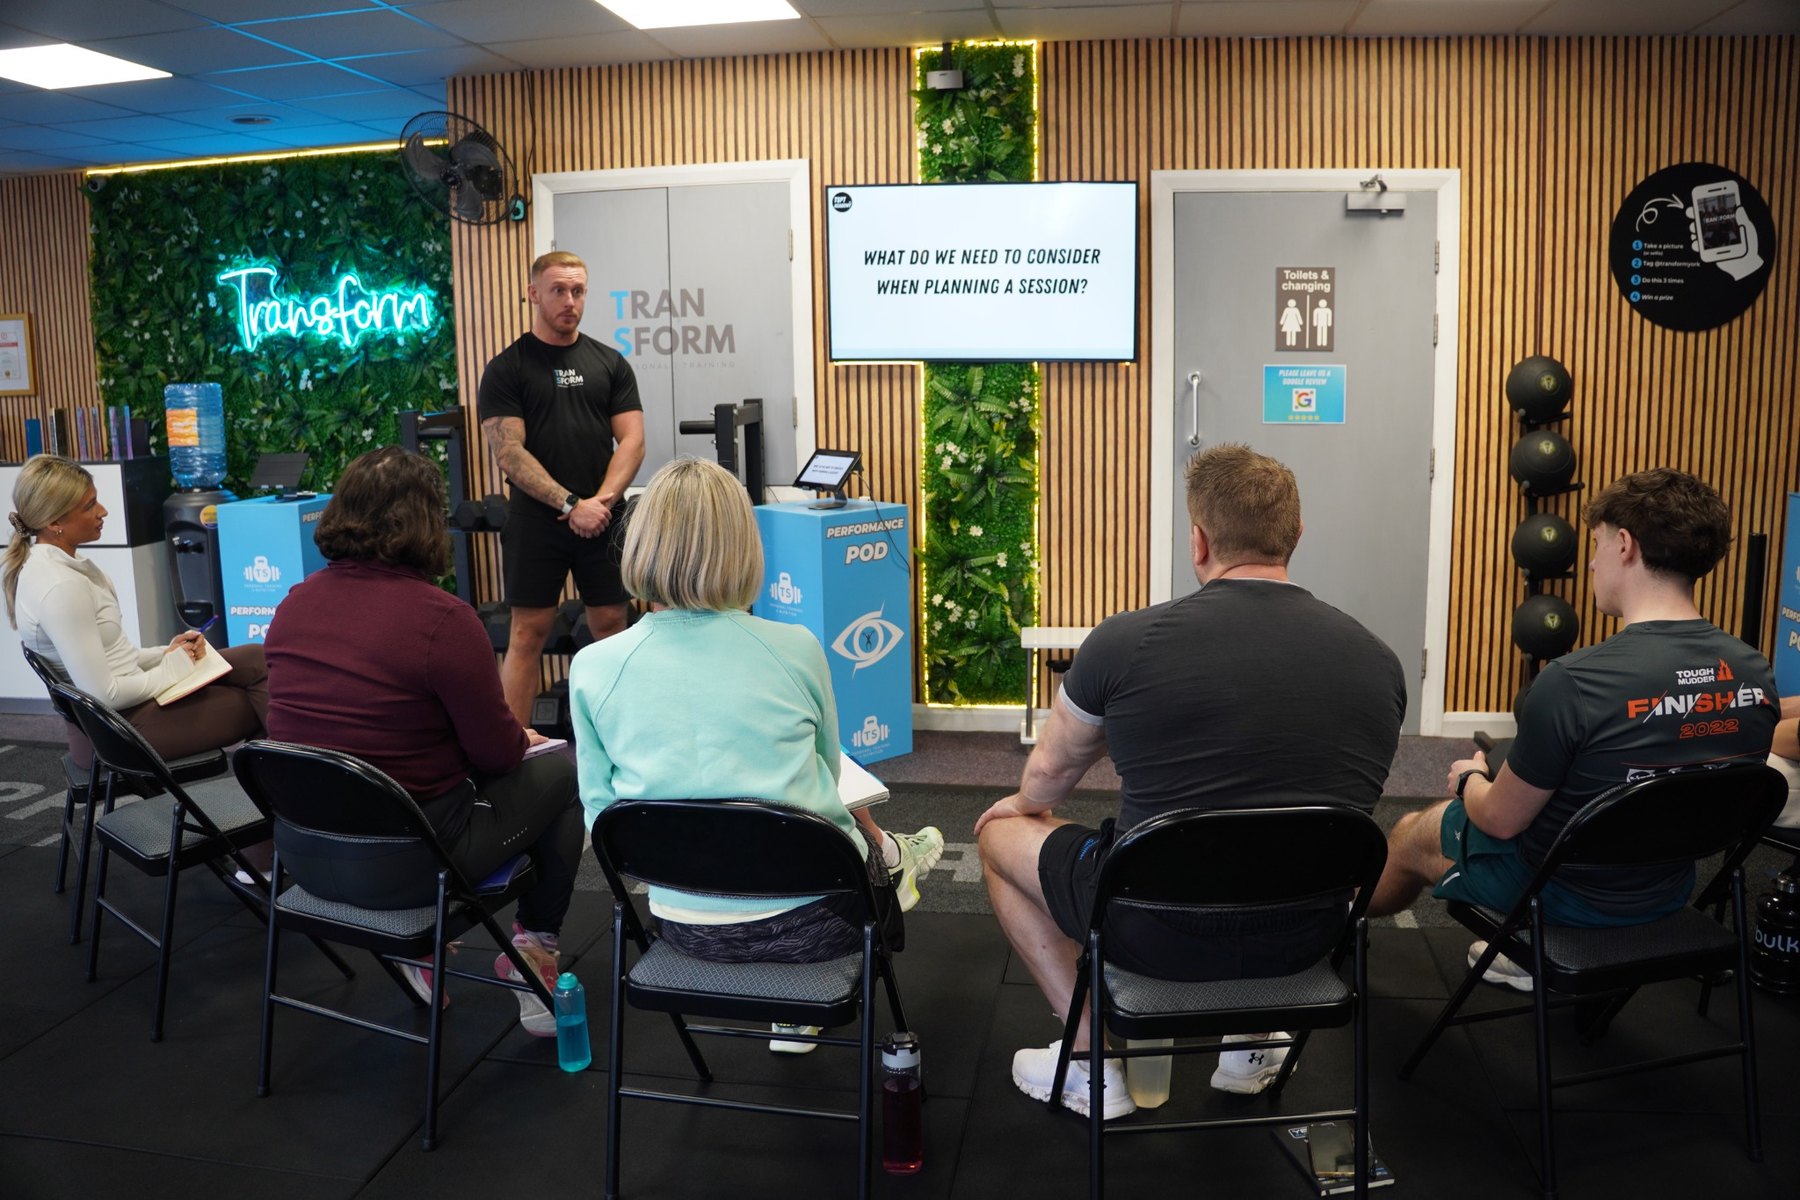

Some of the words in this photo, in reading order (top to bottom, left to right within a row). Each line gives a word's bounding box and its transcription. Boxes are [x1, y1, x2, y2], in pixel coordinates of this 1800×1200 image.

[864, 250, 905, 265] WHAT
[909, 250, 929, 265] DO
[935, 249, 956, 265] WE
[961, 249, 998, 265] NEED
[1004, 249, 1021, 264] TO
[1027, 248, 1101, 264] CONSIDER
[1284, 270, 1318, 280] Toilets
[1321, 270, 1329, 280] &
[877, 280, 919, 295] WHEN
[924, 279, 1000, 294] PLANNING
[1004, 279, 1013, 294] A
[1019, 278, 1088, 294] SESSION?
[1282, 281, 1331, 293] changing
[219, 266, 430, 349] Transform
[609, 288, 705, 320] TRAN
[613, 324, 736, 357] SFORM
[826, 518, 905, 538] PERFORMANCE
[845, 541, 889, 564] POD
[256, 568, 269, 578] TS
[780, 586, 792, 598] TS
[230, 606, 276, 616] PERFORM
[1676, 668, 1714, 679] TOUGH
[1678, 676, 1715, 685] MUDDER
[1627, 685, 1769, 721] FINISHER
[864, 730, 878, 741] TS
[1679, 719, 1740, 739] 2022
[1755, 925, 1800, 953] bulk
